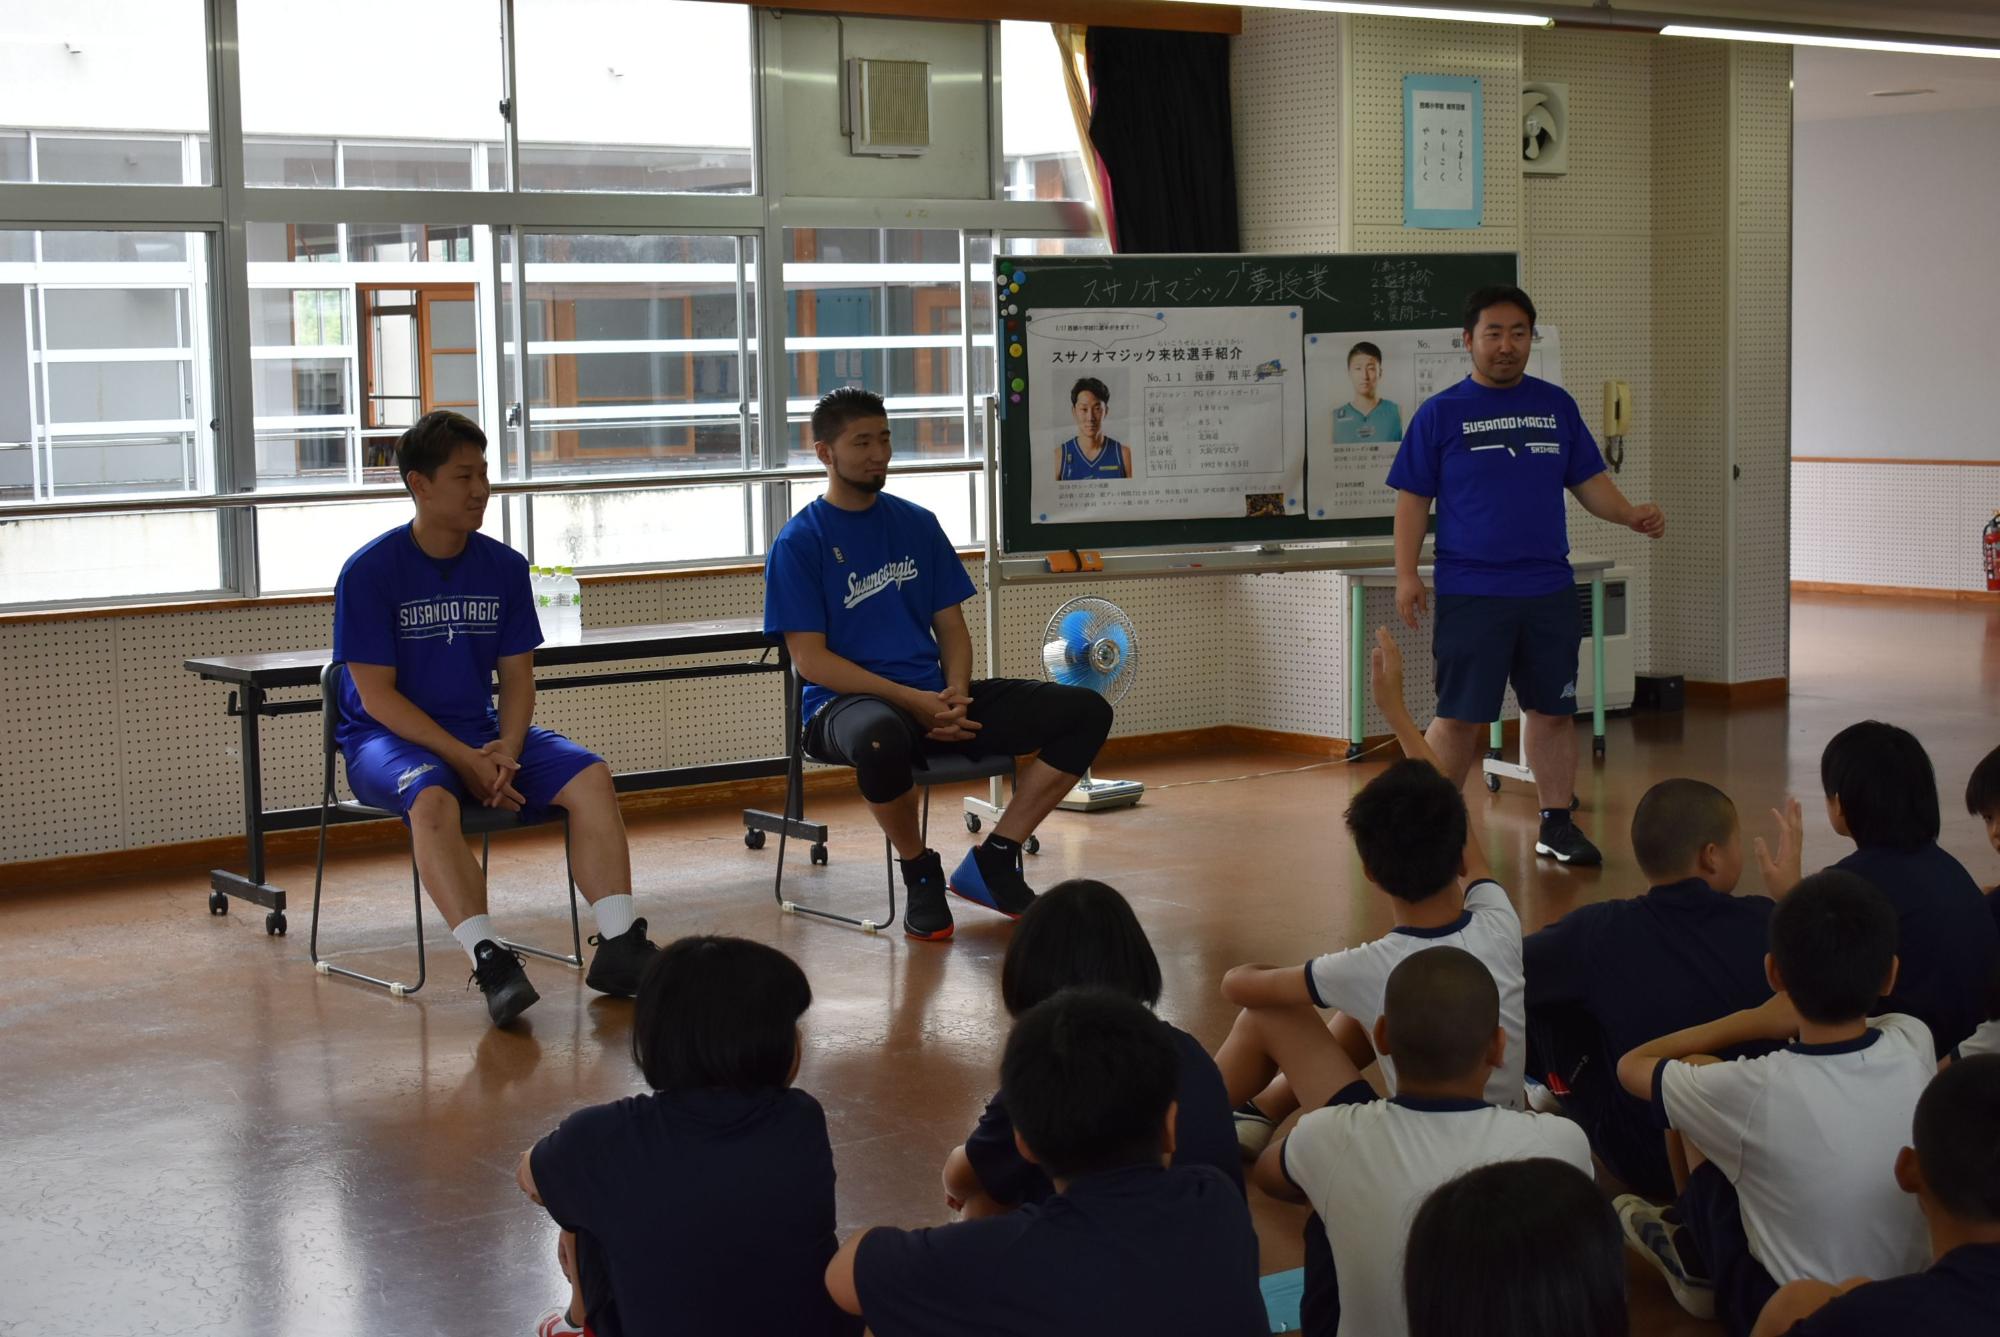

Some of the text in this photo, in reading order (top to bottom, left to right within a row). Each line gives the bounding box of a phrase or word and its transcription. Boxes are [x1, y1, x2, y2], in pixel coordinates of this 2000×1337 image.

[1052, 347, 1243, 363] スサノオマジック来校選手紹介
[1462, 416, 1557, 434] SUSANOO MAGIC
[400, 601, 460, 626] SUSANOO
